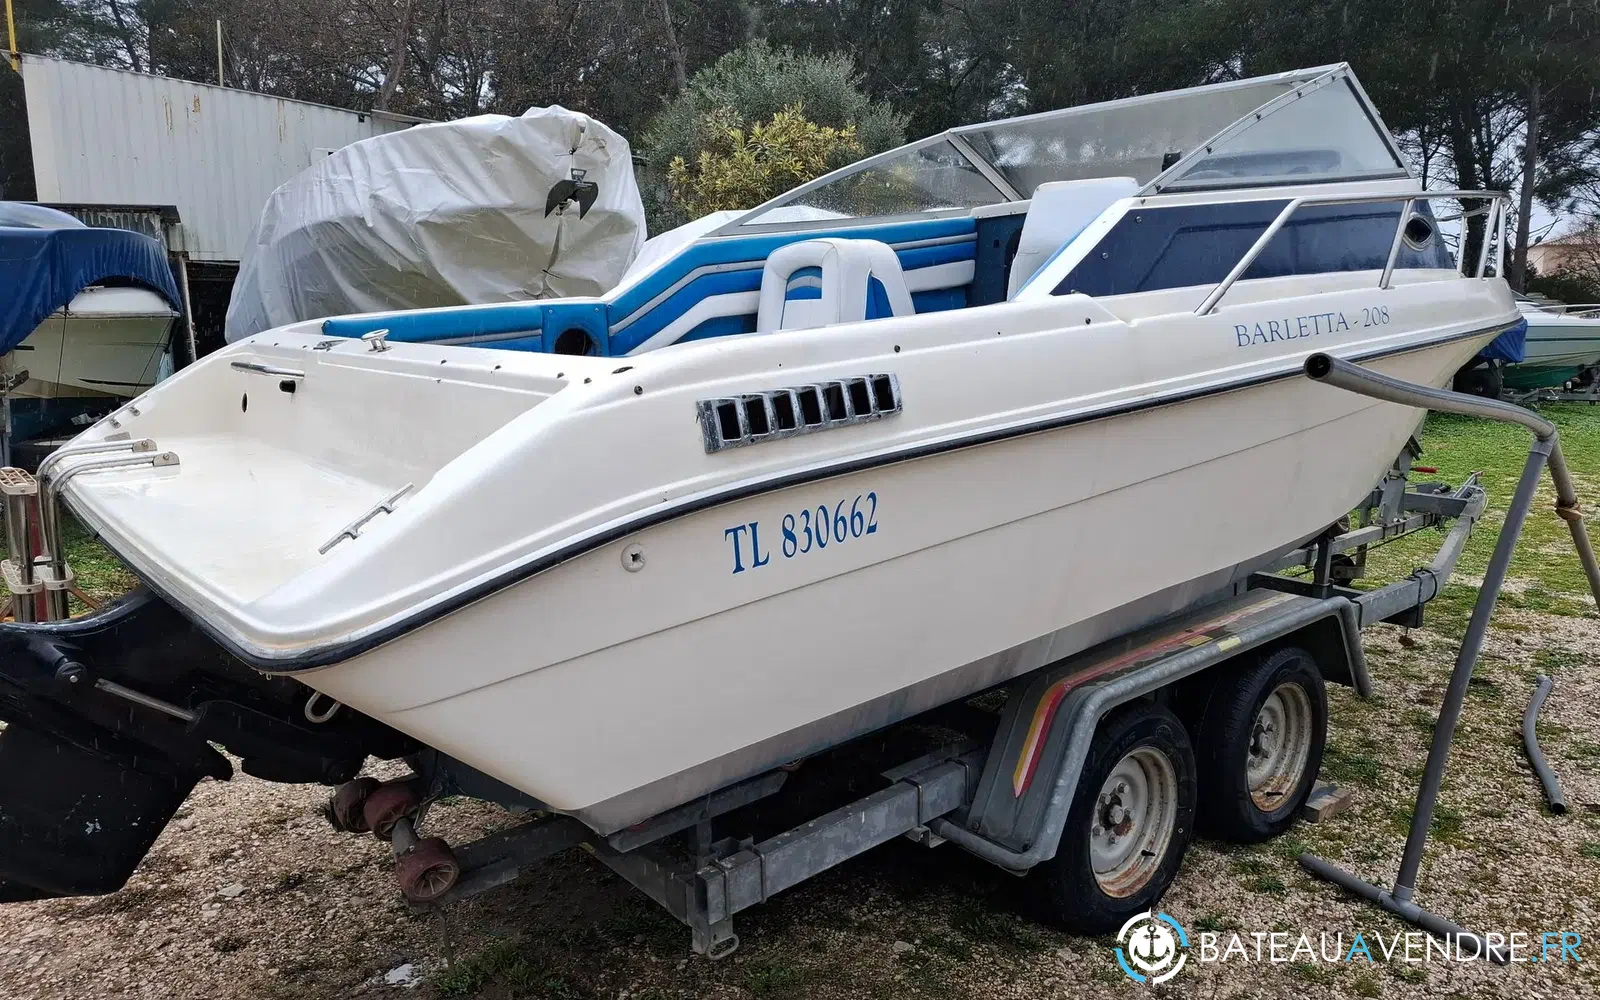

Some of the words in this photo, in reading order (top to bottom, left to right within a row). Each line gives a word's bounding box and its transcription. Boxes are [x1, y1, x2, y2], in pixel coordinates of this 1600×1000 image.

[1233, 312, 1350, 347] BARLETTA
[1362, 305, 1390, 328] 208
[724, 521, 770, 574] TL
[781, 491, 878, 558] 830662
